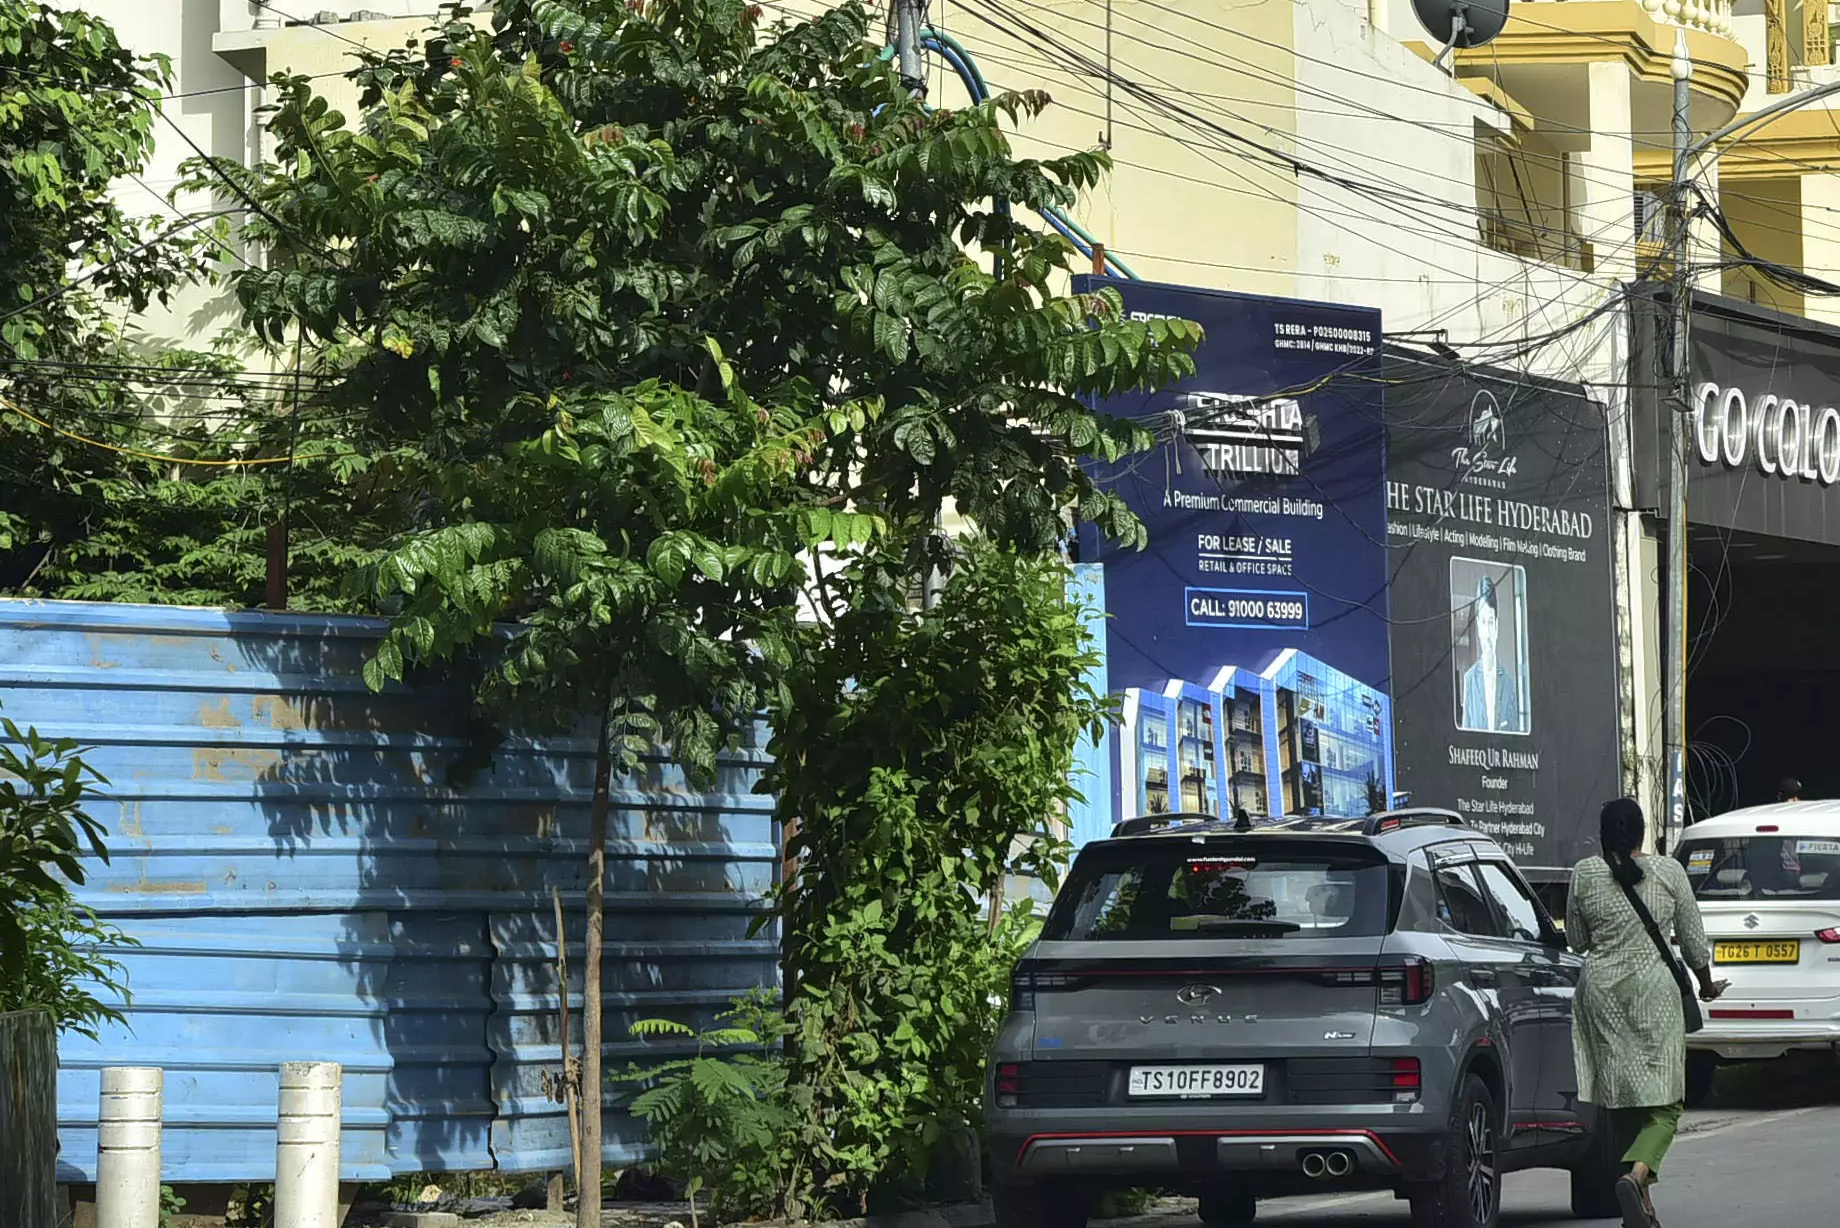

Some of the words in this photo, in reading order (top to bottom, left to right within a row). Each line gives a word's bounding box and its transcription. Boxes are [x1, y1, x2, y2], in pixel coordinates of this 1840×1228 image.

[1274, 322, 1285, 335] TS
[1285, 323, 1306, 336] RERA
[1696, 382, 1747, 466] GO
[1451, 447, 1470, 469] The
[1497, 456, 1518, 477] Life
[1163, 489, 1172, 508] A
[1174, 490, 1220, 511] Premium
[1221, 494, 1281, 515] Commercial
[1283, 498, 1323, 520] Building
[1386, 480, 1410, 512] HE
[1415, 485, 1456, 519] STAR
[1459, 493, 1493, 524] LIFE
[1497, 499, 1593, 539] HYDERABAD
[1198, 535, 1220, 551] FOR
[1222, 536, 1256, 552] LEASE
[1265, 539, 1292, 555] SALE
[1386, 523, 1409, 537] ashion
[1444, 530, 1465, 547] Acting
[1503, 536, 1516, 551] Film
[1568, 547, 1587, 563] Brand
[1199, 559, 1228, 573] RETAIL
[1236, 561, 1265, 575] OFFICE
[1267, 563, 1293, 576] SPACE
[1191, 598, 1226, 617] CALL:
[1228, 599, 1264, 618] 91000
[1266, 601, 1303, 620] 63999
[1481, 775, 1508, 789] Founder
[1457, 798, 1471, 812] The
[1471, 798, 1485, 813] Star
[1485, 800, 1498, 813] Life
[1499, 801, 1535, 816] Hyderabad
[1501, 822, 1533, 837] Hyderabad
[1533, 823, 1546, 839] City
[1720, 943, 1750, 959] TG26
[1765, 943, 1797, 959] 0557
[1141, 1069, 1261, 1091] TS10FF8902
